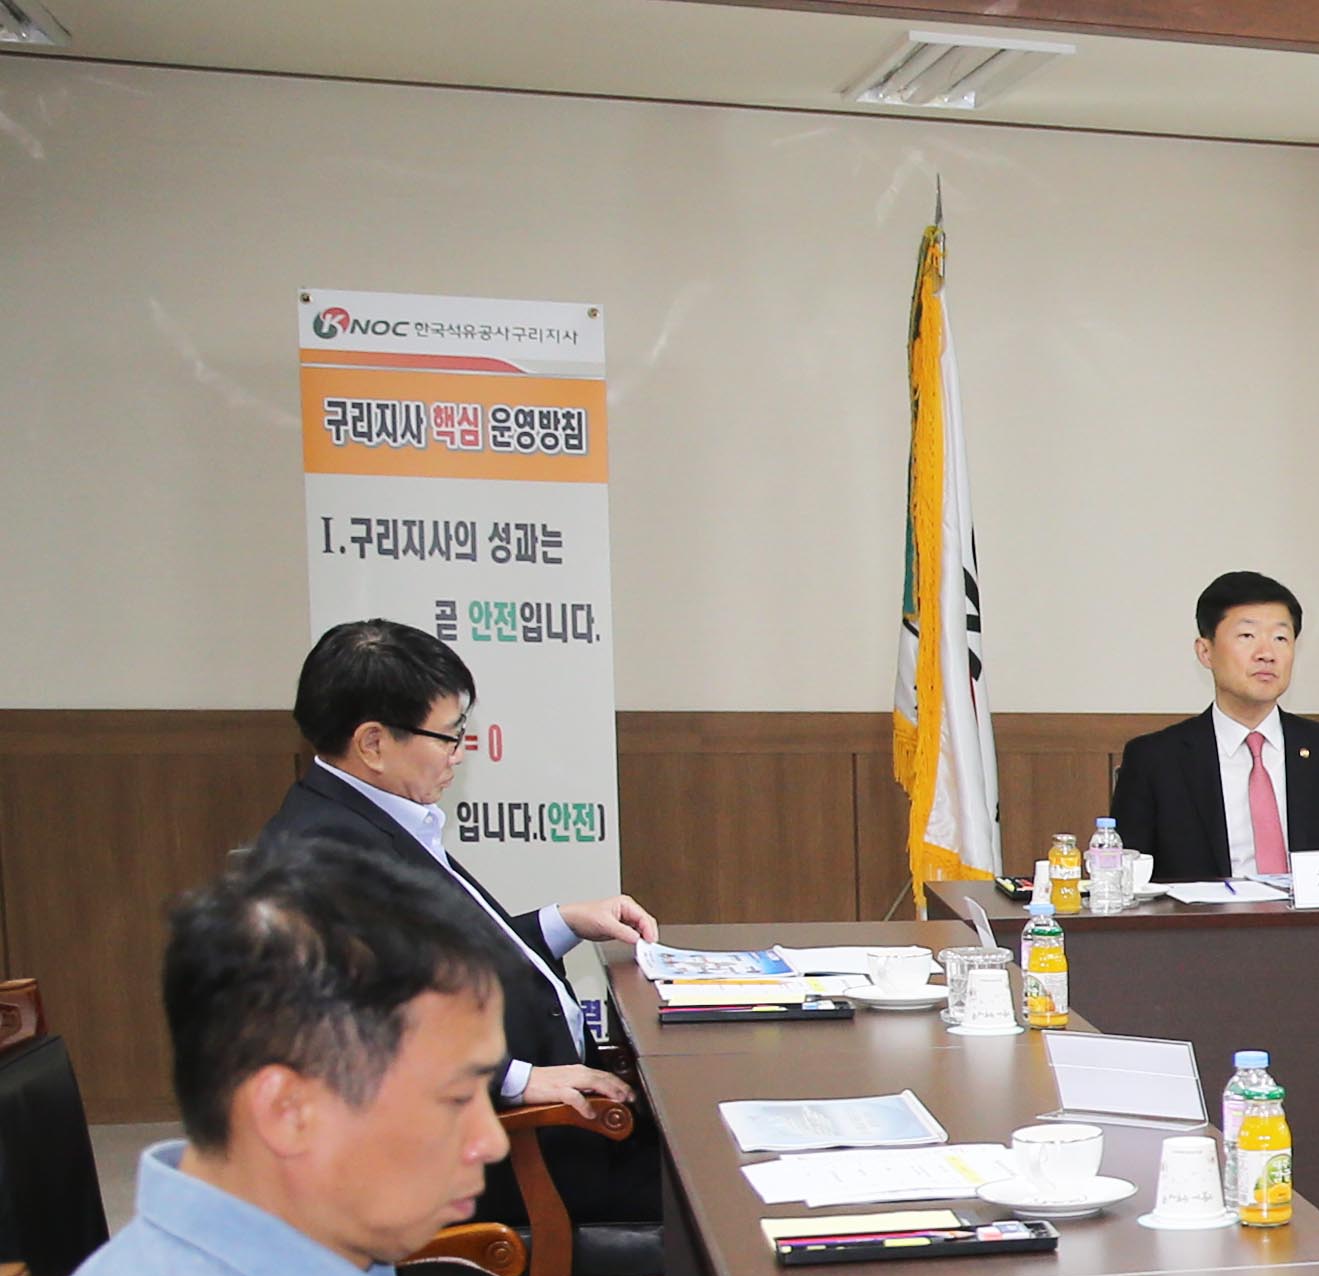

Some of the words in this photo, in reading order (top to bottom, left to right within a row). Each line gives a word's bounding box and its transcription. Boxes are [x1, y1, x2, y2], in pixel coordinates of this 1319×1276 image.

[325, 400, 424, 445] 구리지사
[433, 405, 480, 447] 핵심
[490, 407, 585, 451] 운영방침
[488, 522, 563, 565] 성과는
[435, 600, 458, 641] 곧
[468, 600, 600, 643] 안전입니다.
